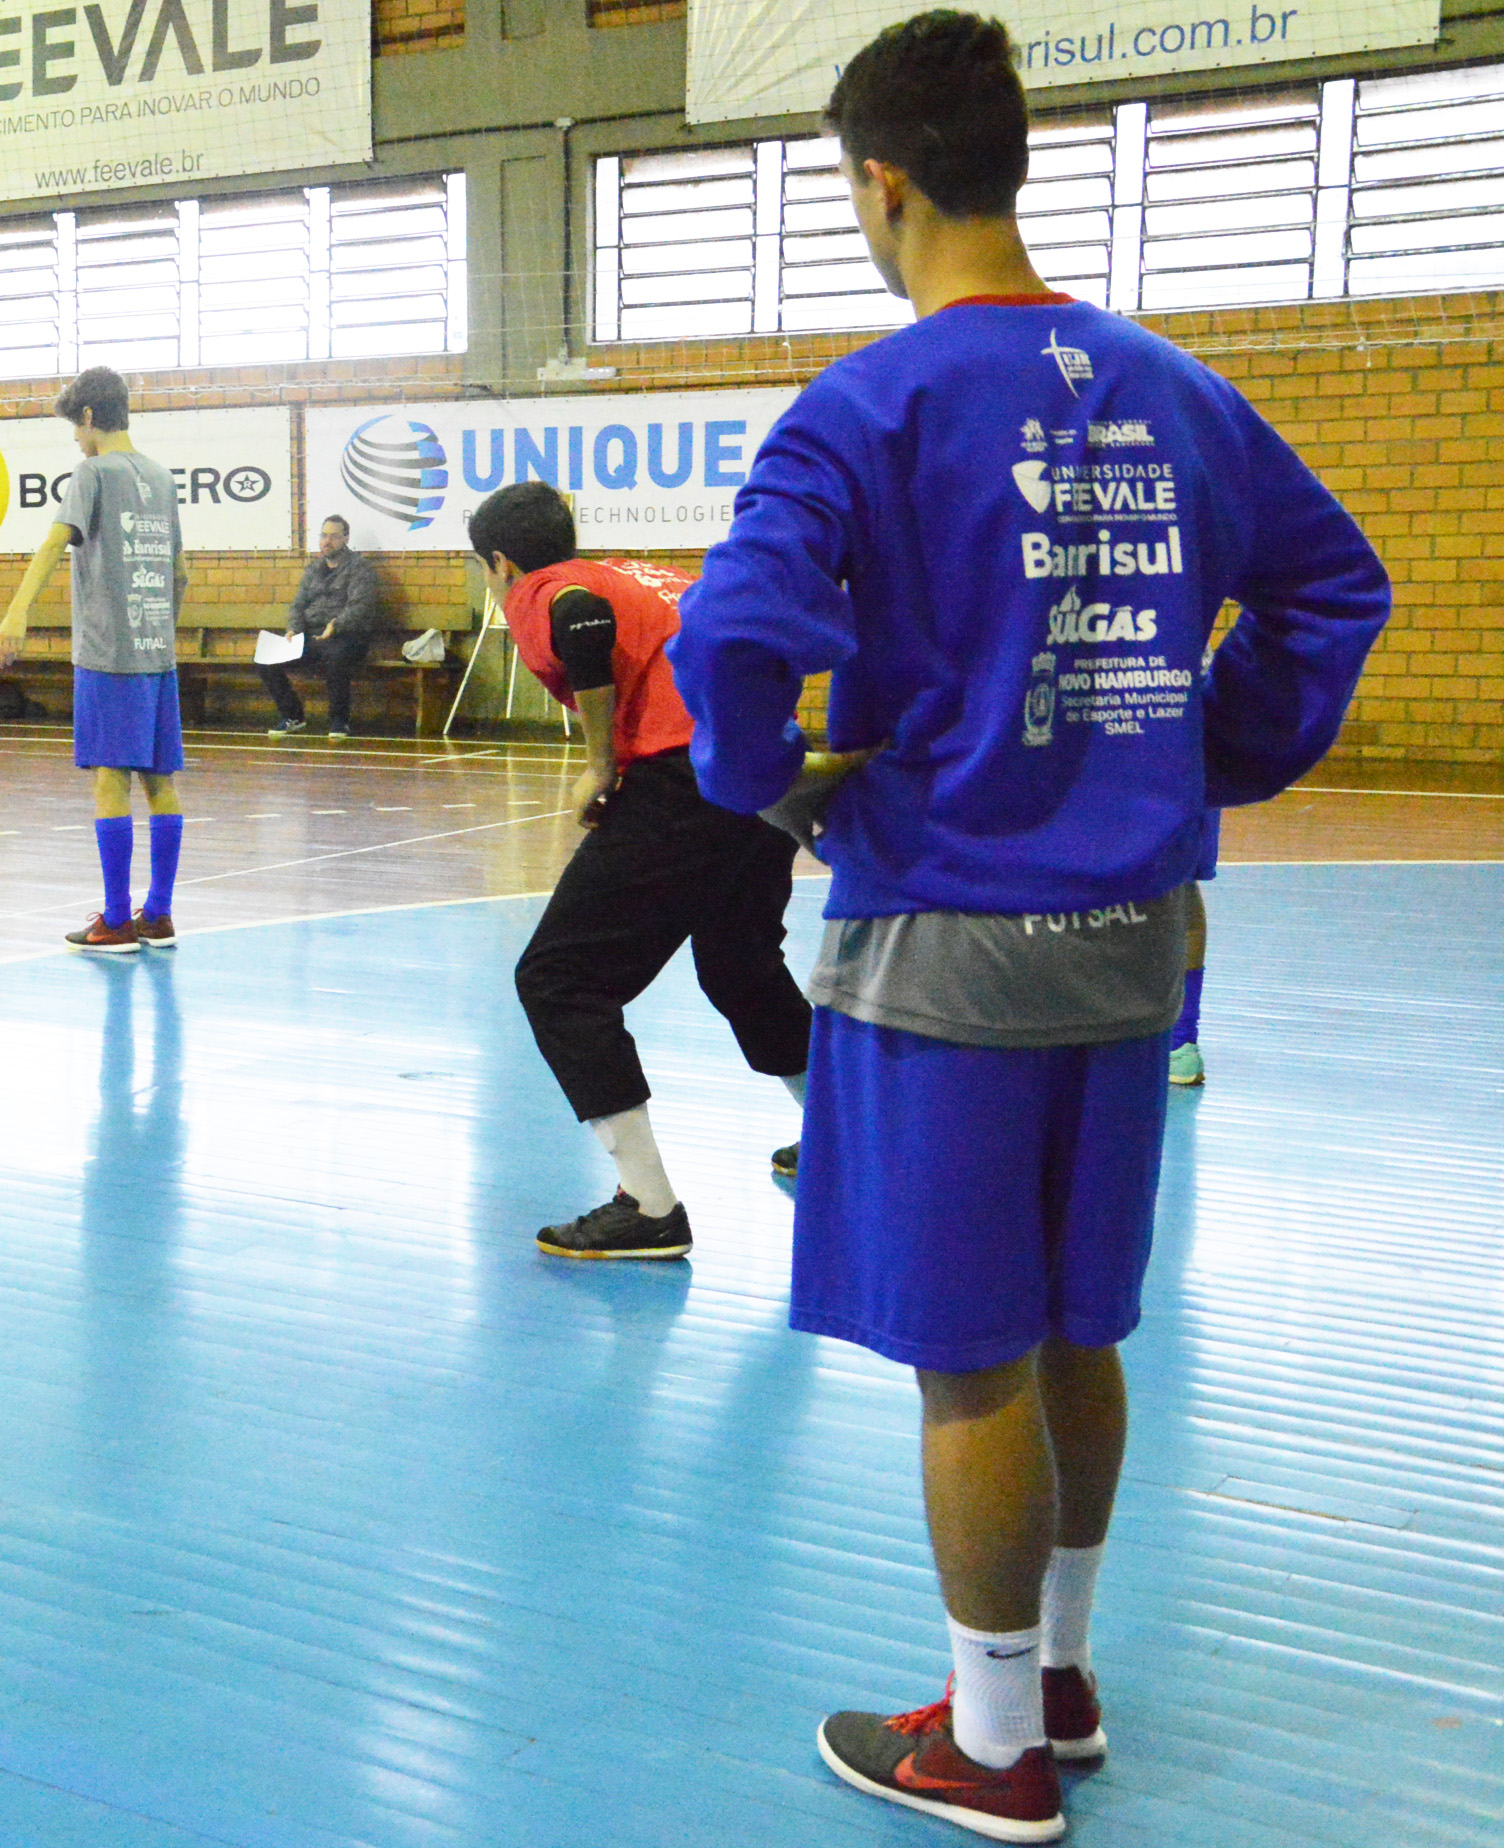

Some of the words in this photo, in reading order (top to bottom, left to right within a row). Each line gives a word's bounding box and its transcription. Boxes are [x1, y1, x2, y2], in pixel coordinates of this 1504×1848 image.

[79, 101, 133, 124] PARA
[136, 90, 214, 118] INOVAR
[218, 87, 234, 108] O
[238, 76, 322, 105] MUNDO
[34, 148, 205, 189] www.feevale.br
[462, 419, 747, 493] UNIQUE
[579, 504, 735, 524] ECHNOLOGIE
[1073, 656, 1147, 670] PREFEITURA
[1148, 655, 1167, 667] DE
[1093, 668, 1194, 690] HAMBURGO
[1124, 690, 1189, 706] Municipal
[1082, 707, 1134, 723] Esporte
[1136, 710, 1146, 719] e
[1148, 704, 1185, 719] Lazer
[1104, 720, 1146, 736] SMEL
